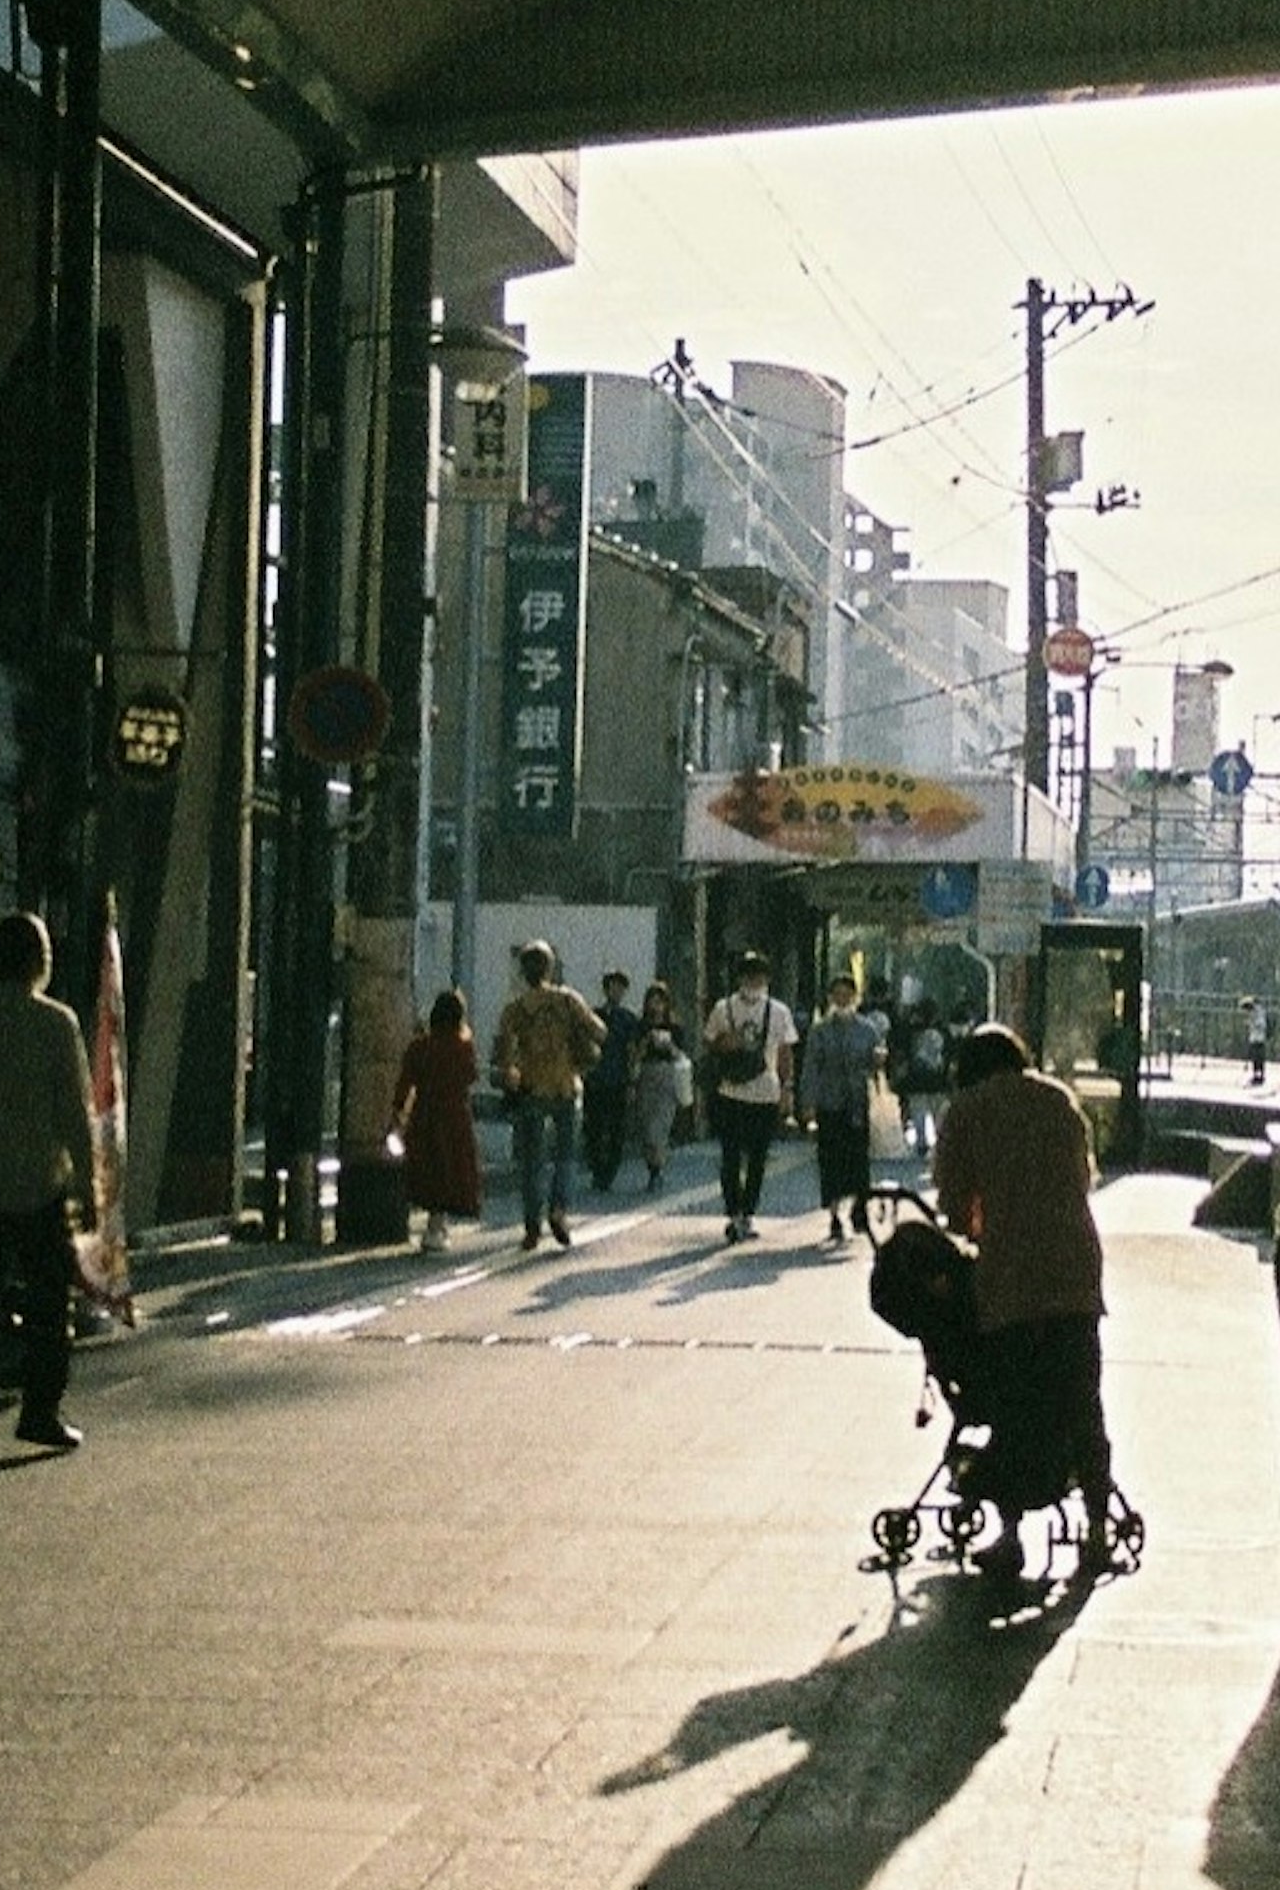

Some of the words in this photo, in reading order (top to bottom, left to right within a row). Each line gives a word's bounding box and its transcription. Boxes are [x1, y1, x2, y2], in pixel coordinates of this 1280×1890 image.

[514, 589, 566, 809] 伊予銀行
[780, 798, 910, 824] おのみち
